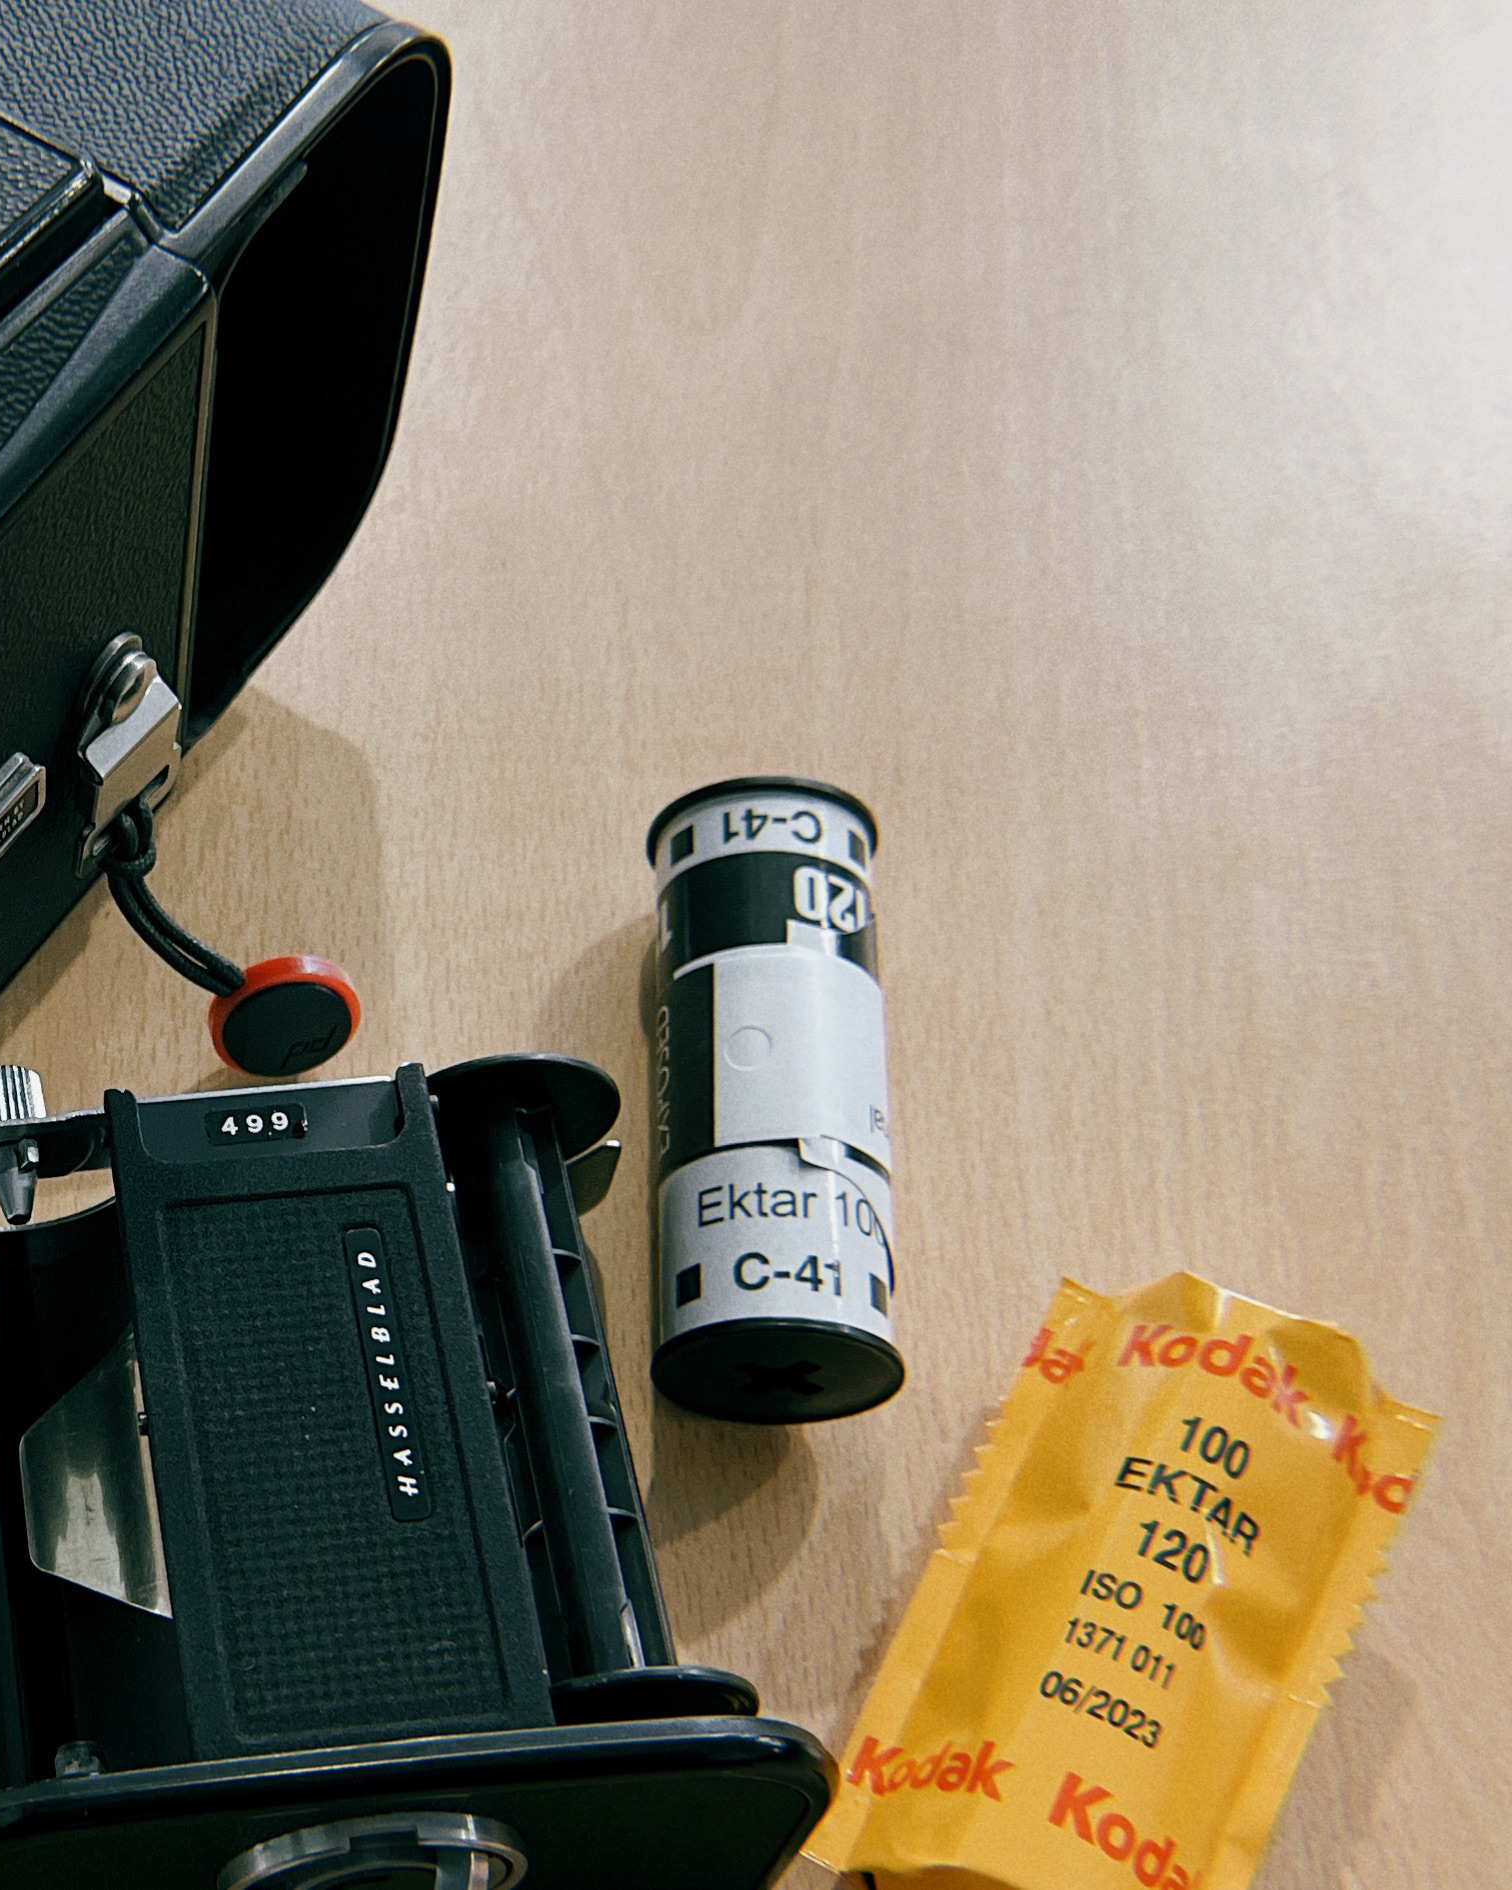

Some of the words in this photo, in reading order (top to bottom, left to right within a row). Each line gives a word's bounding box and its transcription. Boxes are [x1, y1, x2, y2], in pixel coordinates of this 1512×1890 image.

[721, 808, 823, 846] C-41
[220, 1110, 289, 1137] 499
[697, 1182, 818, 1229] Ektar
[732, 1251, 843, 1297] C-41
[356, 1251, 420, 1497] HASSELBLAD
[1117, 1323, 1311, 1429] Kodak
[1180, 1415, 1252, 1481] 100
[1114, 1456, 1261, 1558] EKTAR
[1137, 1520, 1211, 1585] 120
[1080, 1568, 1144, 1612] ISO
[1162, 1602, 1207, 1652] 100
[1064, 1617, 1129, 1663] 1371
[1130, 1645, 1177, 1690] 011
[1038, 1671, 1164, 1751] 06/2023
[845, 1735, 1017, 1803] Kodak
